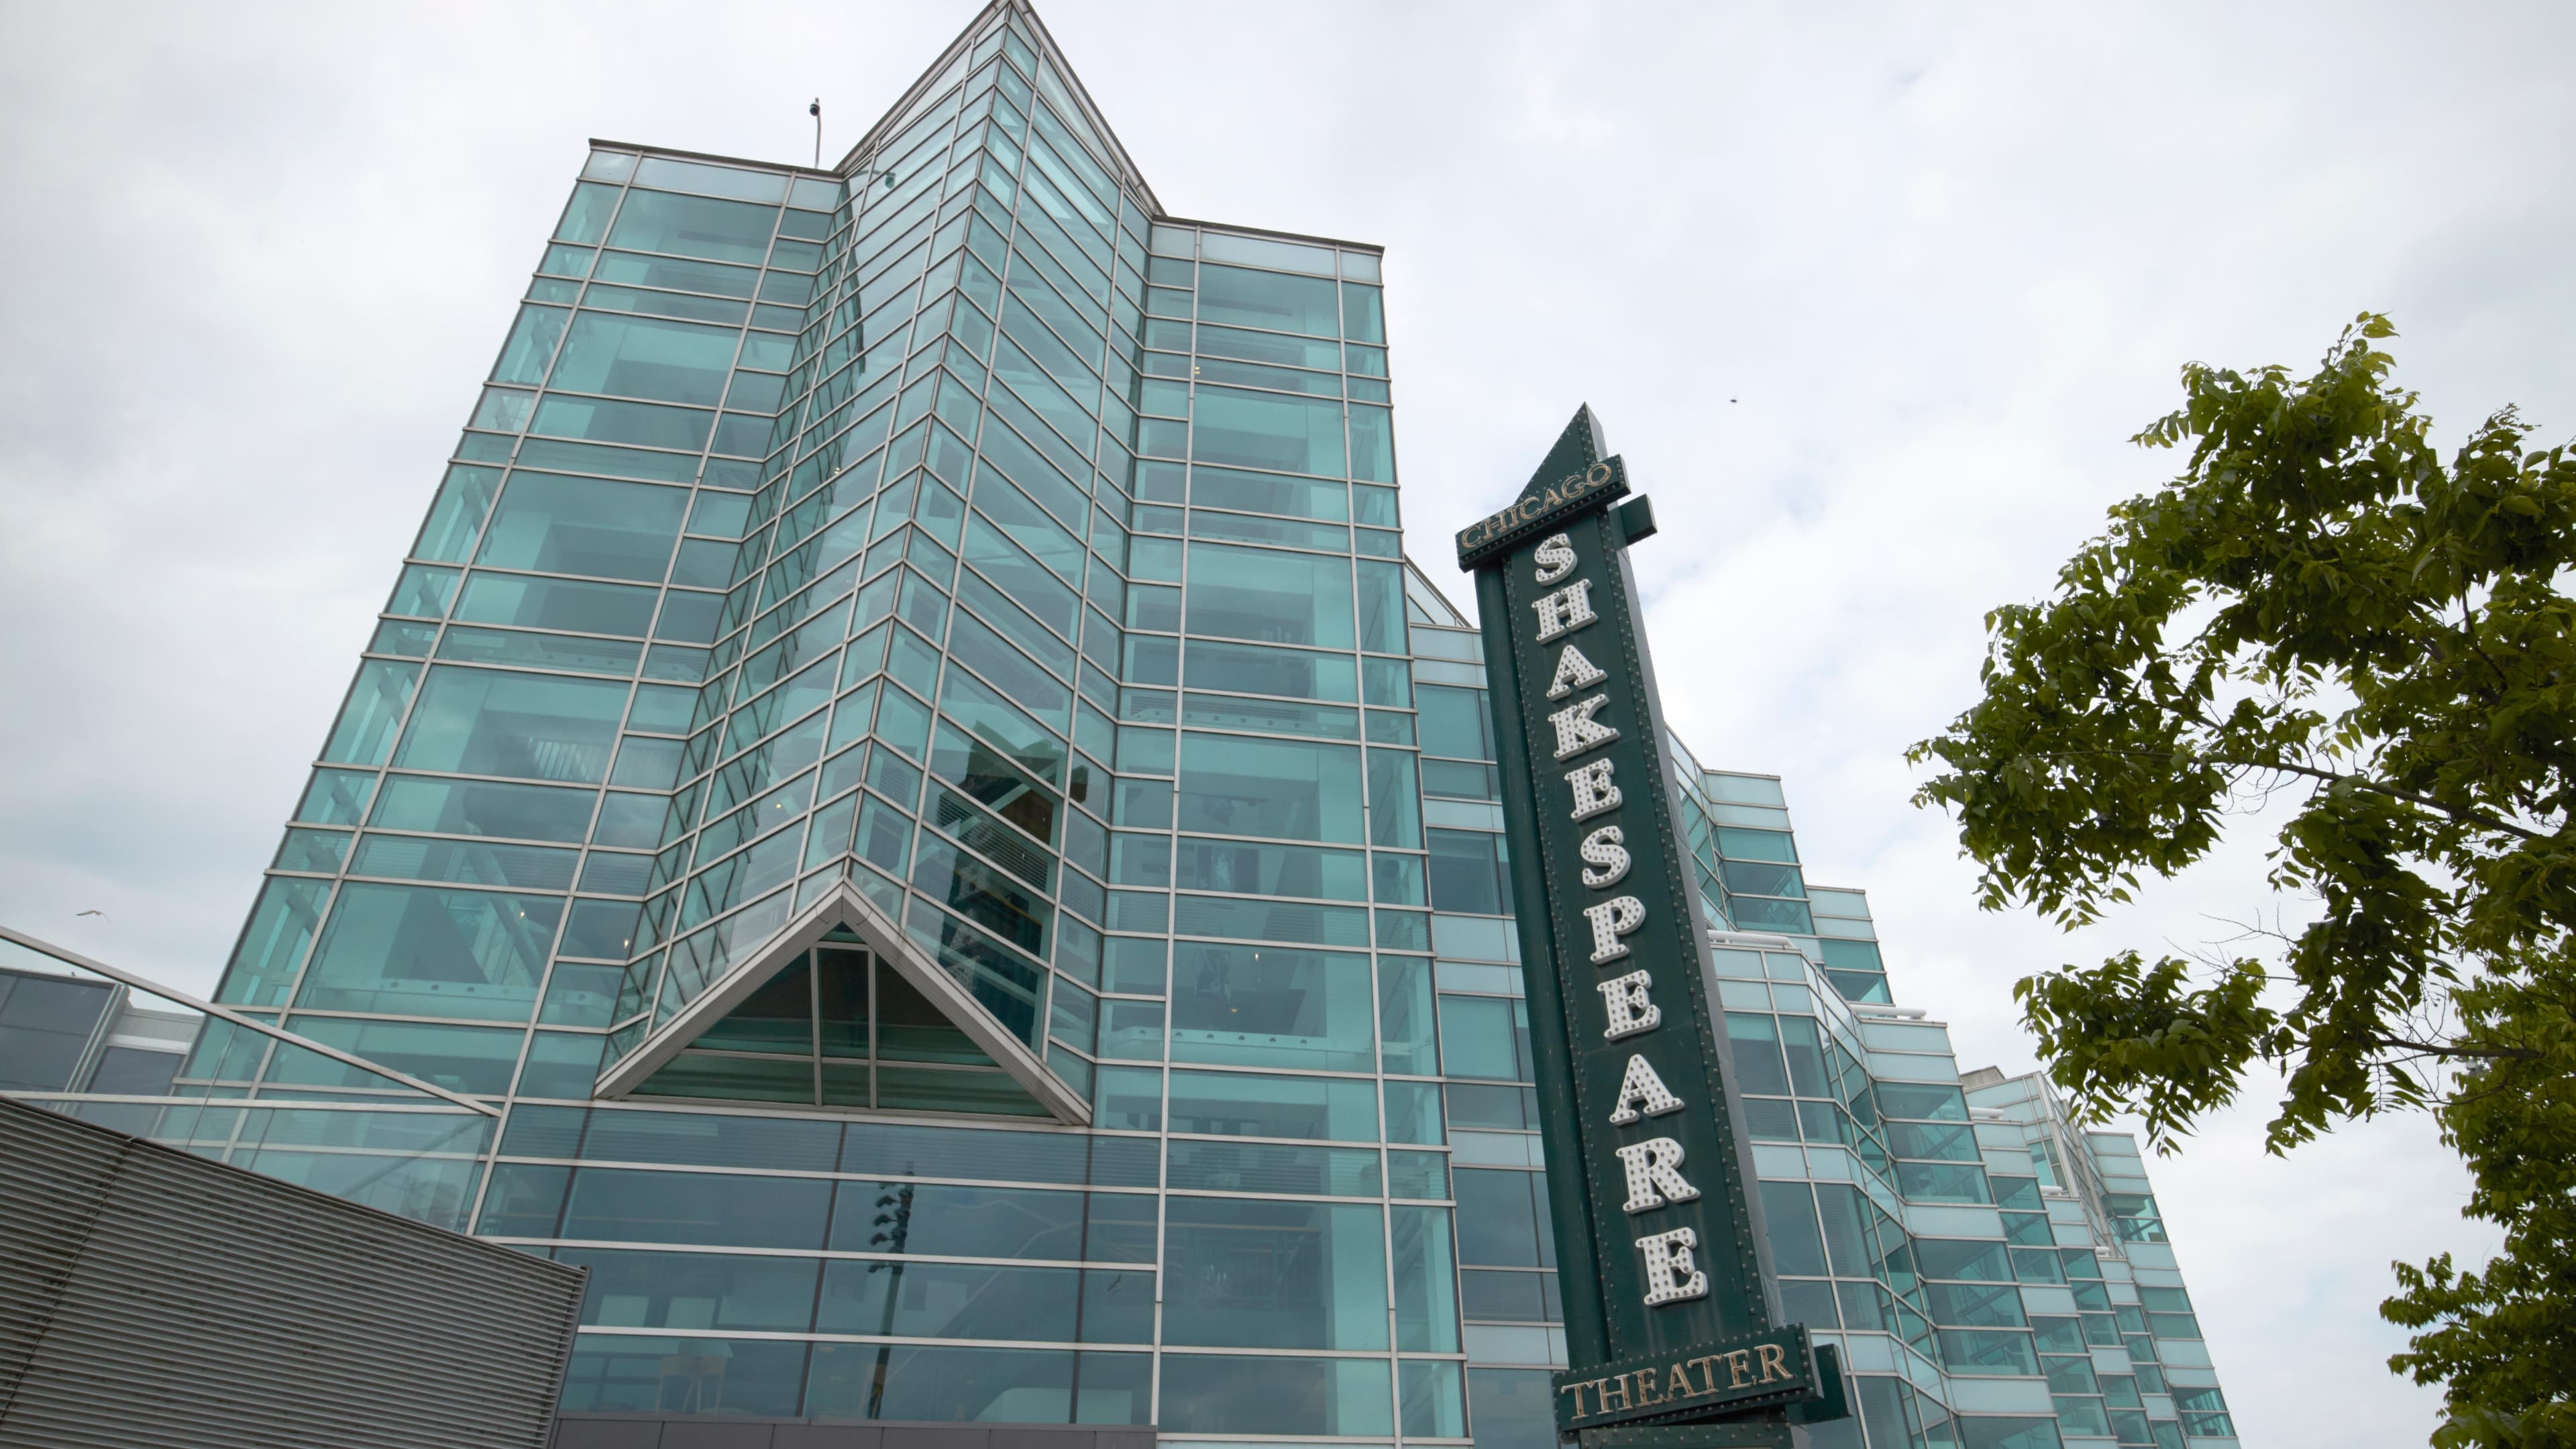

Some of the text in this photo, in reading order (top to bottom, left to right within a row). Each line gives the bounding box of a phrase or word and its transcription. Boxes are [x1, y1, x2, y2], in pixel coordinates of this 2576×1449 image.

[1462, 463, 1611, 547] CHICAGO
[1532, 533, 1709, 1307] SHAKESPEARE
[1561, 1344, 1796, 1421] THEATER
